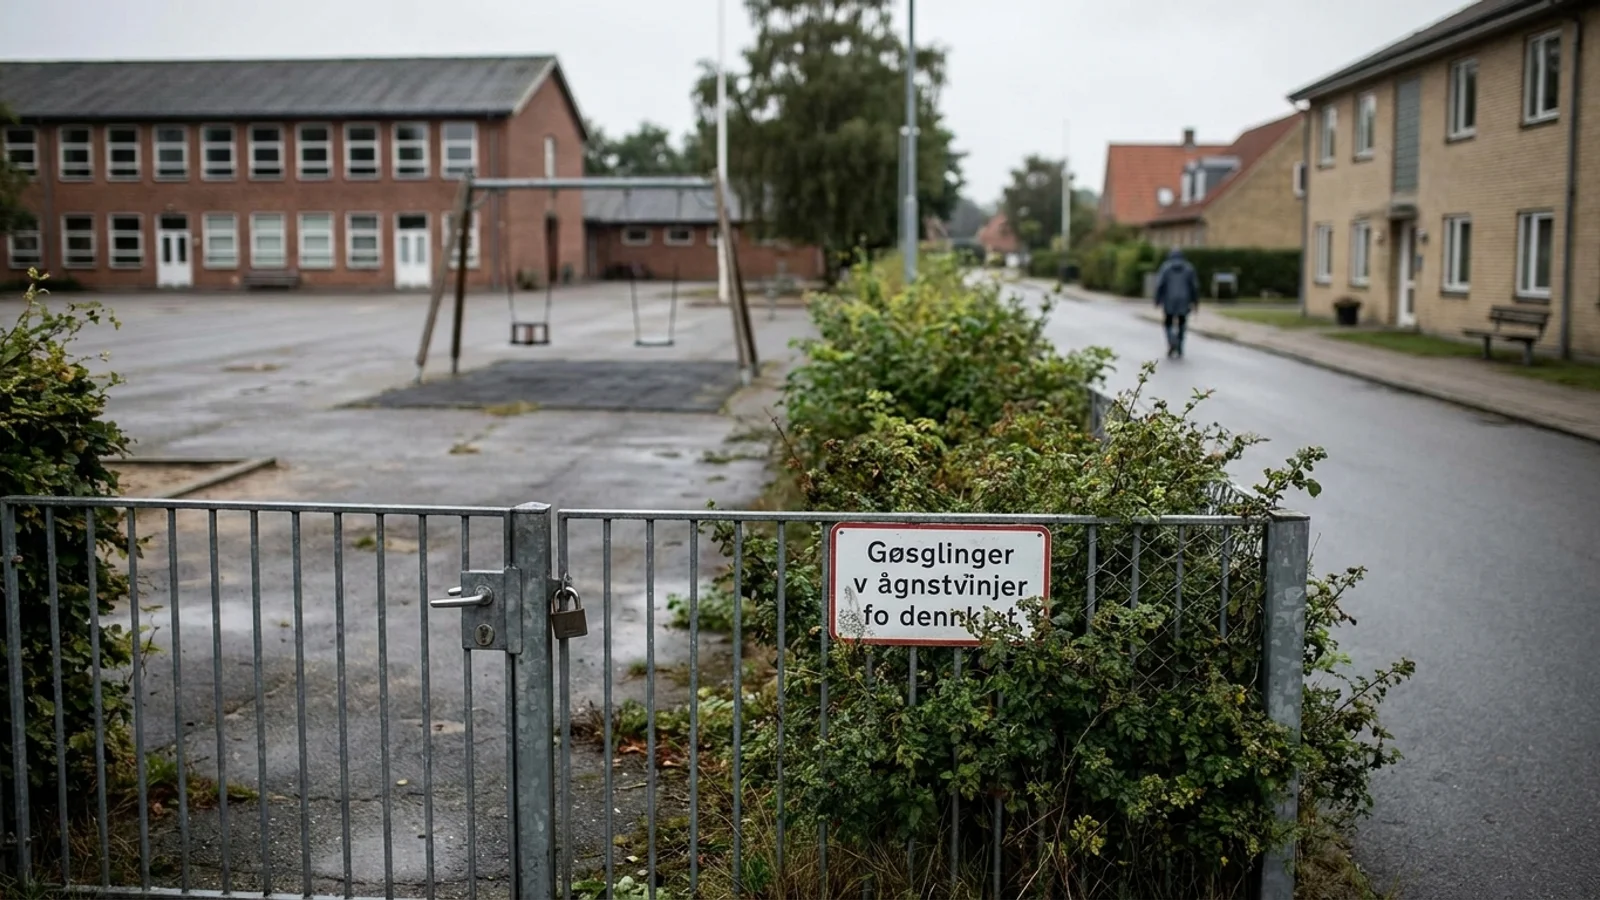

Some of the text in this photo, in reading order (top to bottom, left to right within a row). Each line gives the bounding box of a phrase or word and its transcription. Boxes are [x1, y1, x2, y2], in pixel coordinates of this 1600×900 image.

[867, 541, 1014, 568] Gøsglinger
[853, 577, 868, 593] v
[863, 604, 889, 626] fo
